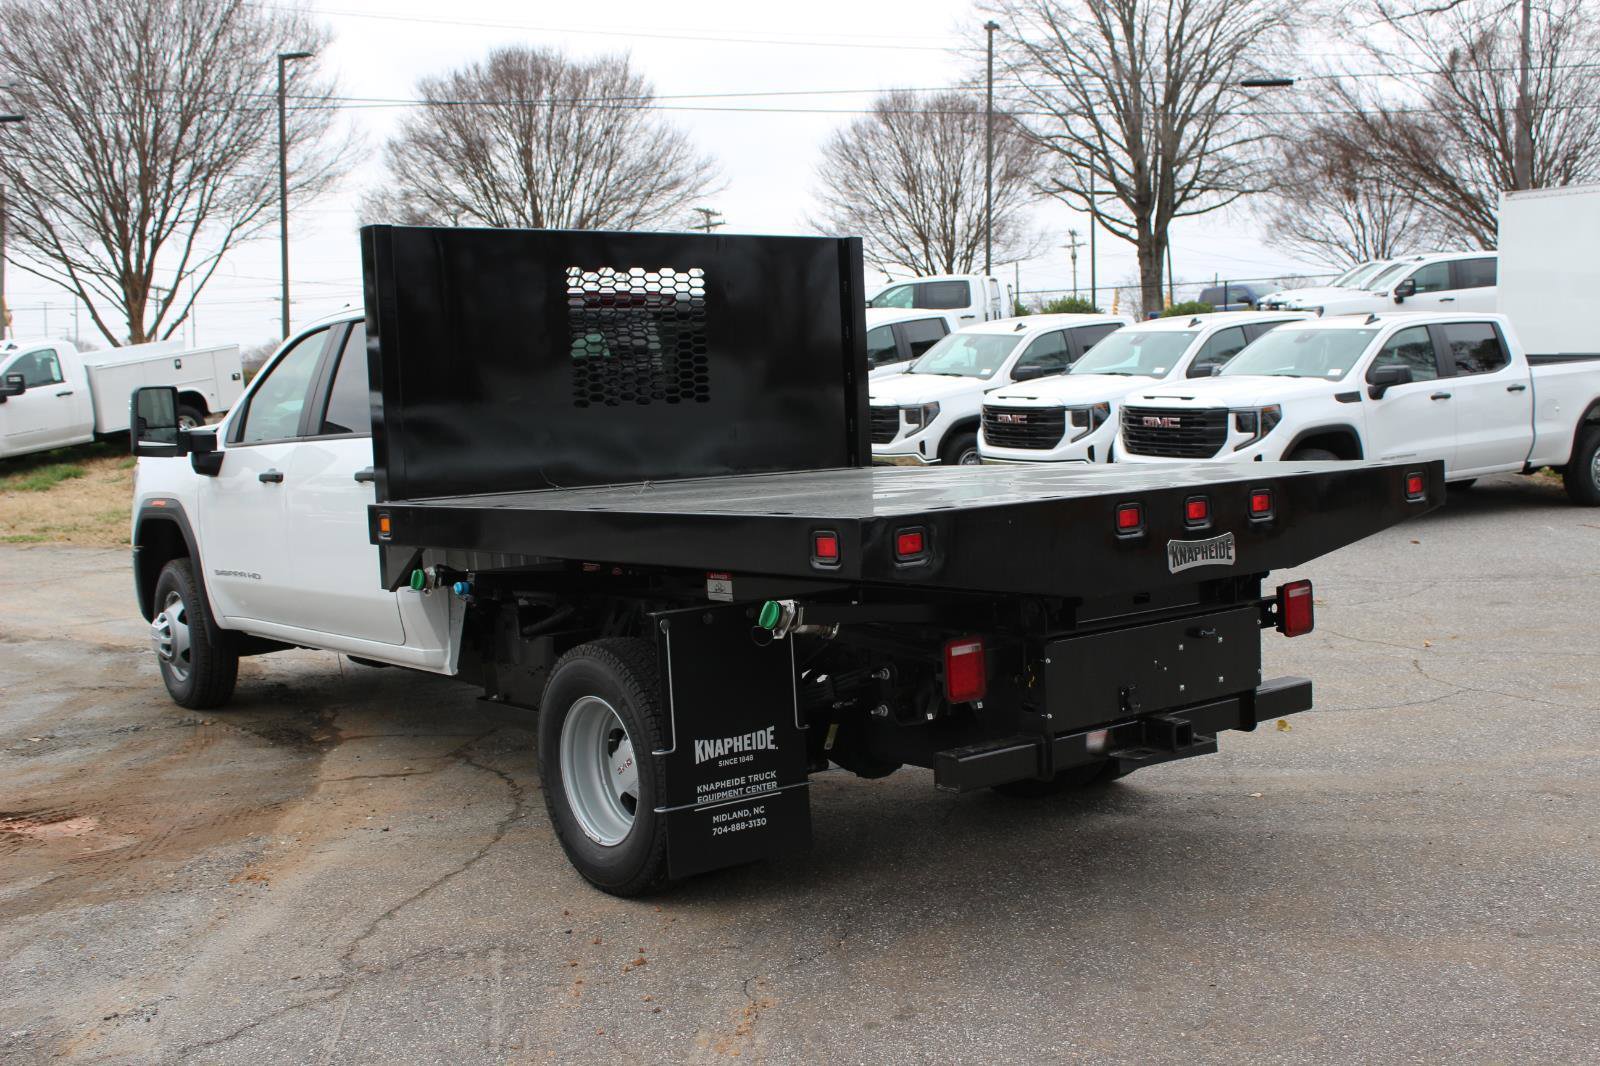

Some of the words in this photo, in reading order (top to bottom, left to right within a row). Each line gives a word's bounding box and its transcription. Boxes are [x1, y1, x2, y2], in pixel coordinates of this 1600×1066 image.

[997, 414, 1028, 425] GMC
[1142, 416, 1181, 428] GMC
[1171, 538, 1234, 568] KNAPHEIDE
[718, 757, 739, 767] SINCE
[739, 754, 754, 764] 1848
[697, 776, 746, 794] KNAPHEIDE
[748, 770, 777, 783] TRUCK
[697, 787, 743, 804] EQUIPMENT
[746, 781, 778, 794] CENTER
[712, 809, 752, 824] MIDLAND,
[753, 805, 765, 815] NC
[712, 817, 767, 836] 704-888-3130
